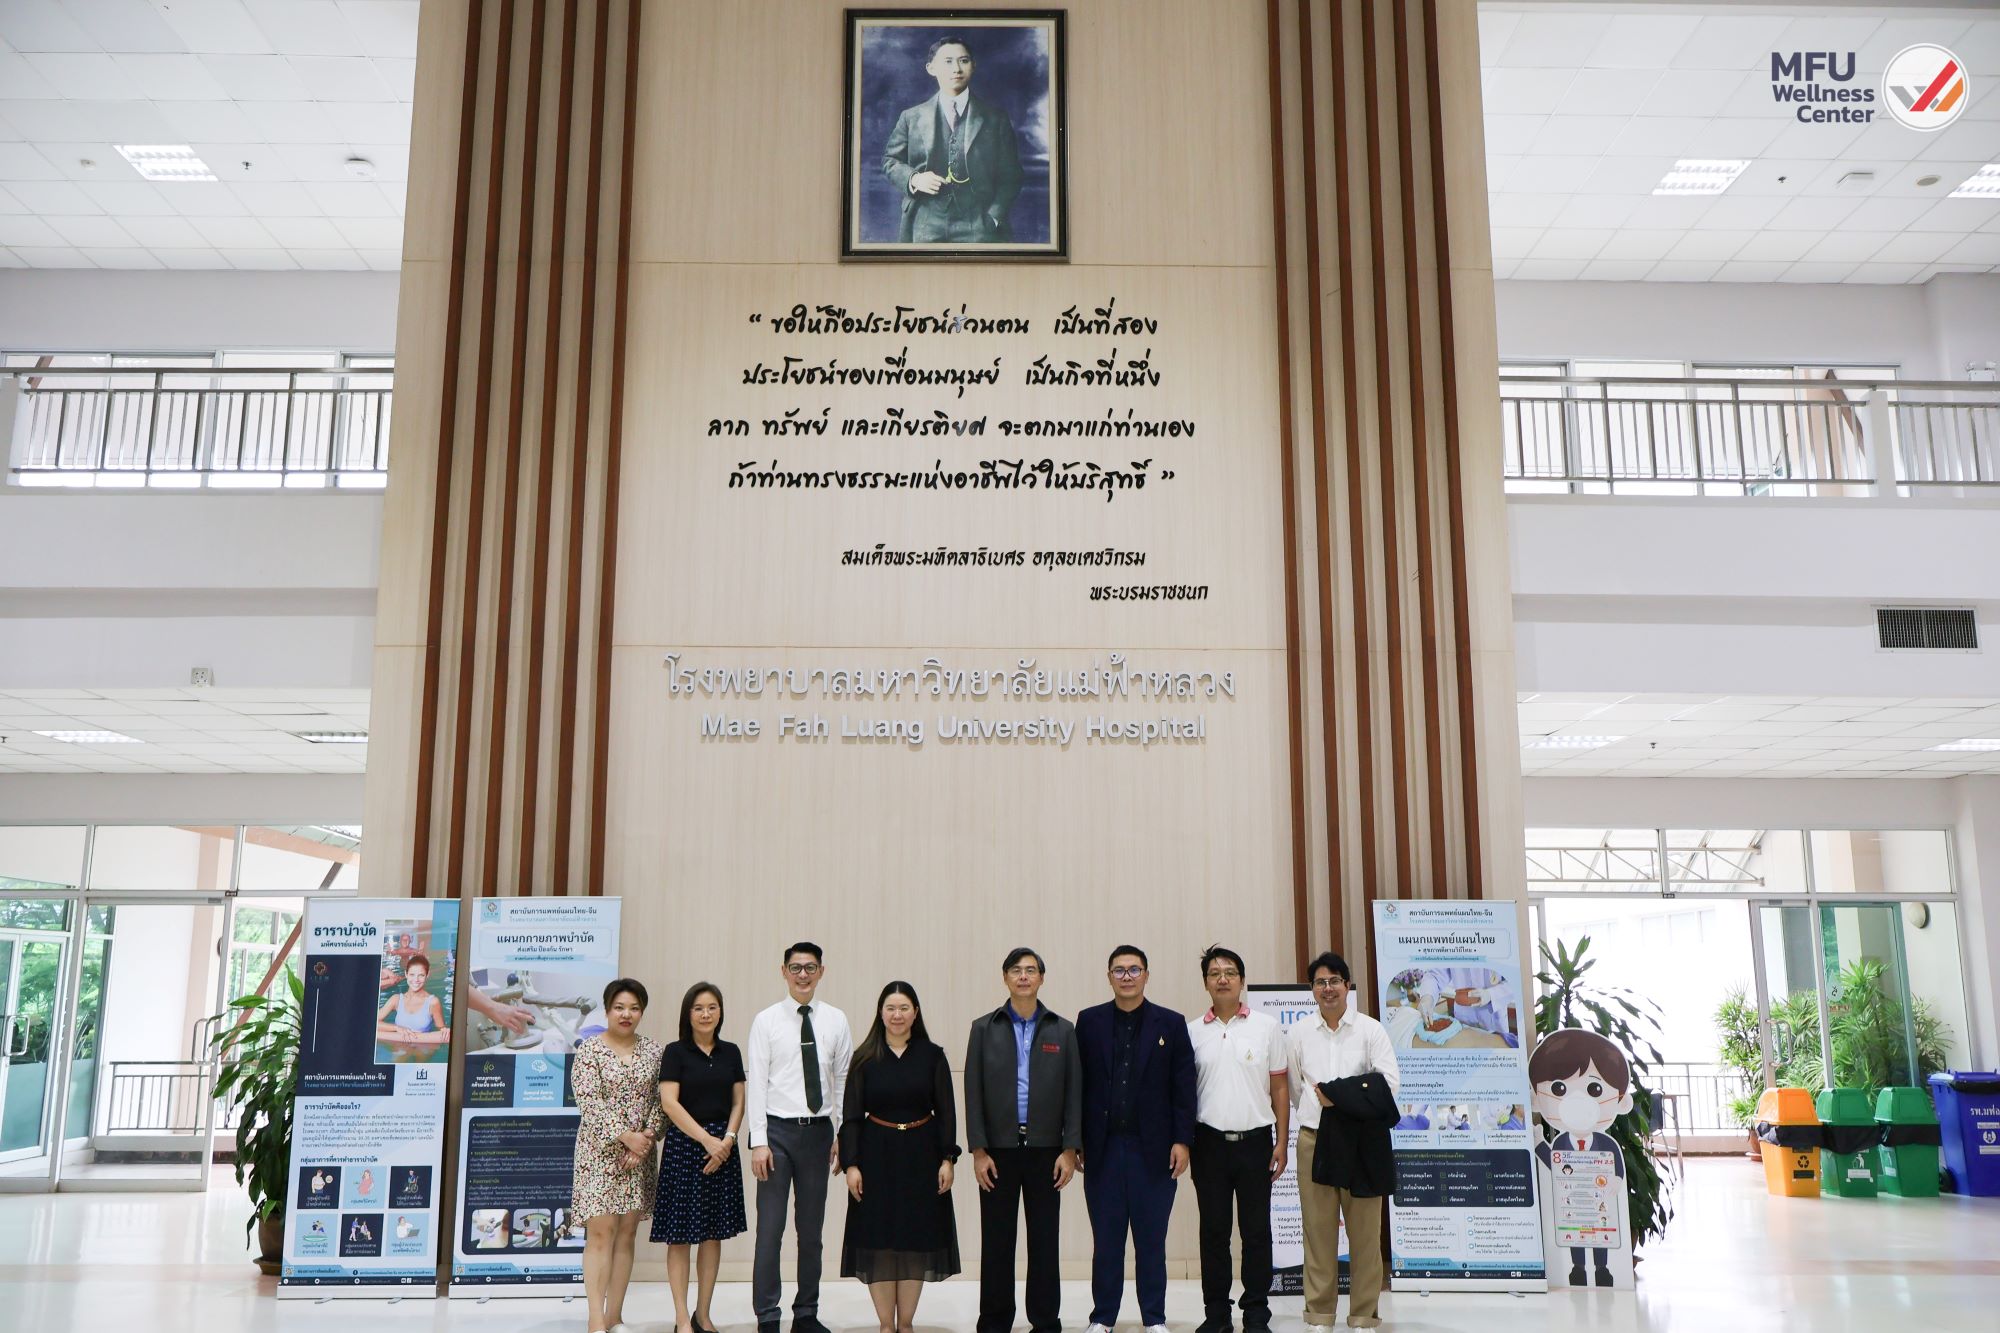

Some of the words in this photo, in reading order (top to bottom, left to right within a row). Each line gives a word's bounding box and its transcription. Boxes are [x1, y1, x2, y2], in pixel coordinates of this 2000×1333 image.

[1053, 296, 1158, 336] เป็นที่สอง
[742, 346, 1002, 400] ประโยชน์ของเพื่อนมนุษย์
[1025, 347, 1161, 387] เป็นกิจที่หนึ่ง
[761, 406, 832, 438] ทรัพย์
[997, 407, 1196, 439] จะตกมาแก่ท่านเอง
[840, 543, 1026, 568] สมเด็จพระมหิตลาธิเบศร
[1032, 547, 1147, 573] อดุลยเดชวิกรม
[1089, 584, 1209, 602] พระบรมราชชนก
[664, 652, 1236, 699] โรงพยาบาลมหาวิทยาลัยแม่ฟ้าหลวง
[701, 714, 761, 738] Mae
[778, 714, 829, 738] Fah
[841, 714, 925, 746] Luang
[938, 714, 1075, 746] University
[1085, 714, 1207, 746] Hospital
[314, 921, 377, 937] ธาราบำบัด
[497, 930, 595, 944] แผนกกายภาพบำบัด
[1398, 931, 1496, 945] แผนกแพทย์แผนไทย
